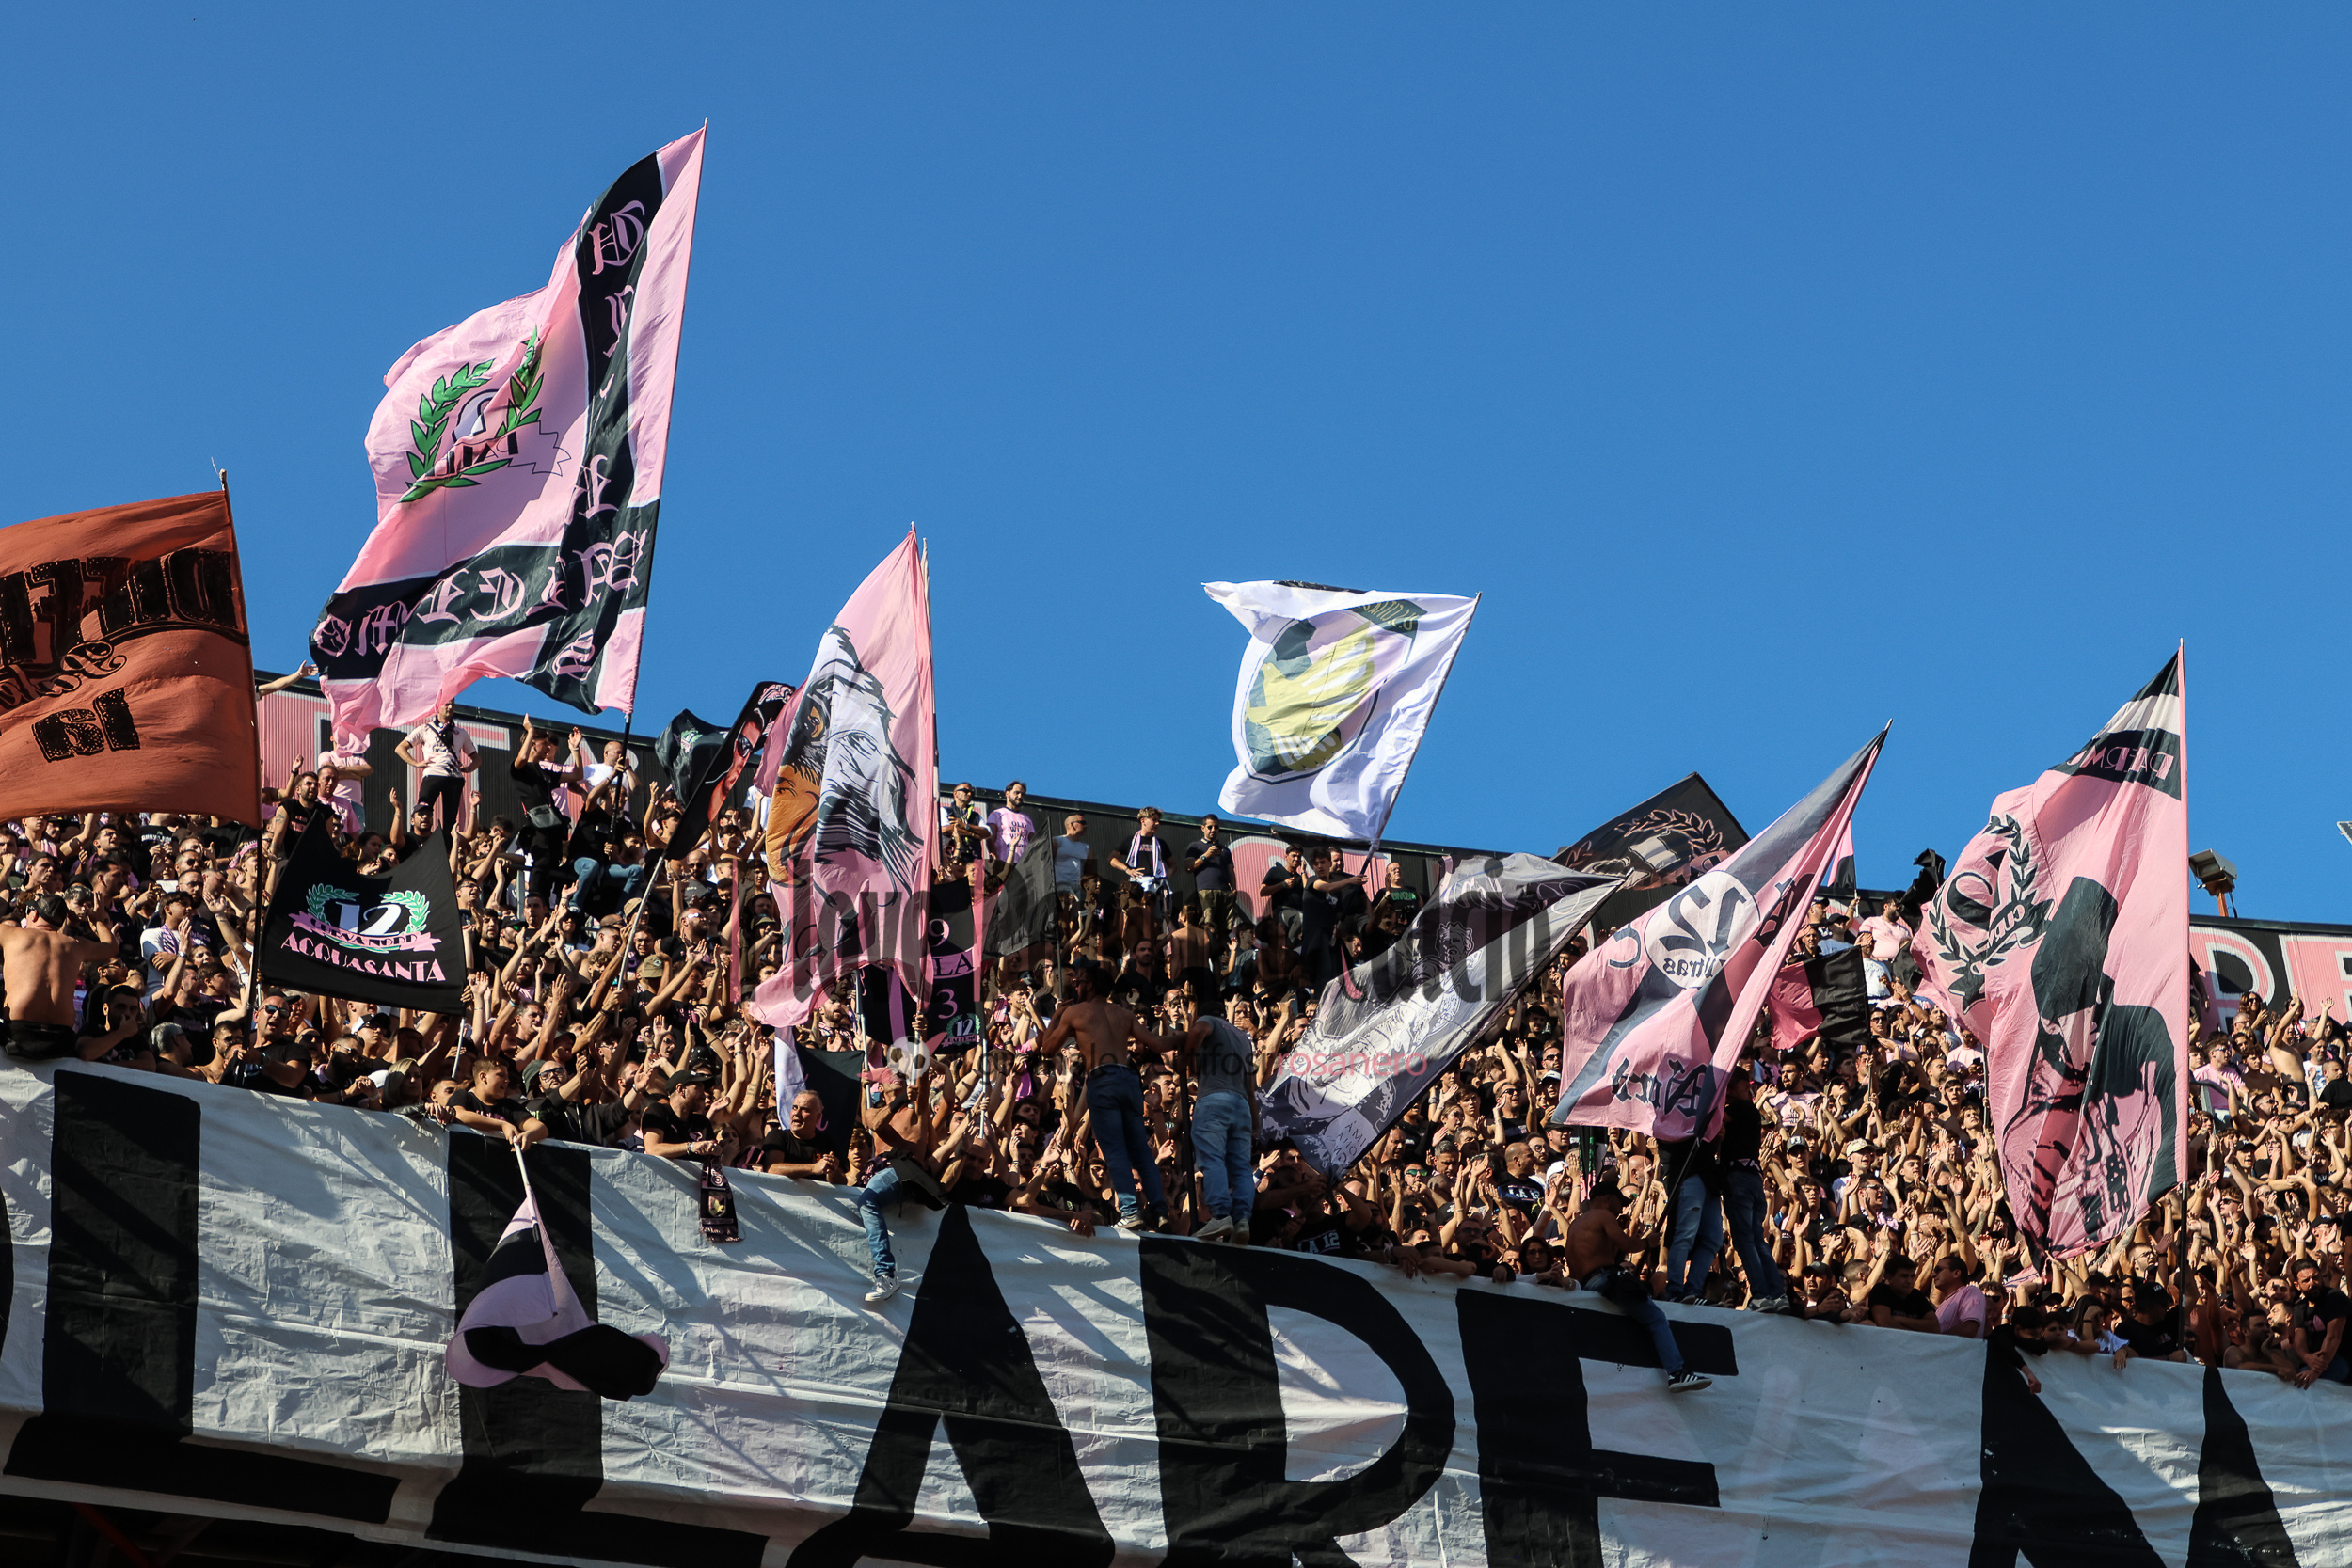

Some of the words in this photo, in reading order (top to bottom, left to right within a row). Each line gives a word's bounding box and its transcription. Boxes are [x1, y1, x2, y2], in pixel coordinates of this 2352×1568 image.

[336, 901, 402, 936] 12
[280, 931, 446, 982] ACQUASANTA
[955, 1019, 975, 1037] 12
[1323, 1231, 1340, 1249] 12
